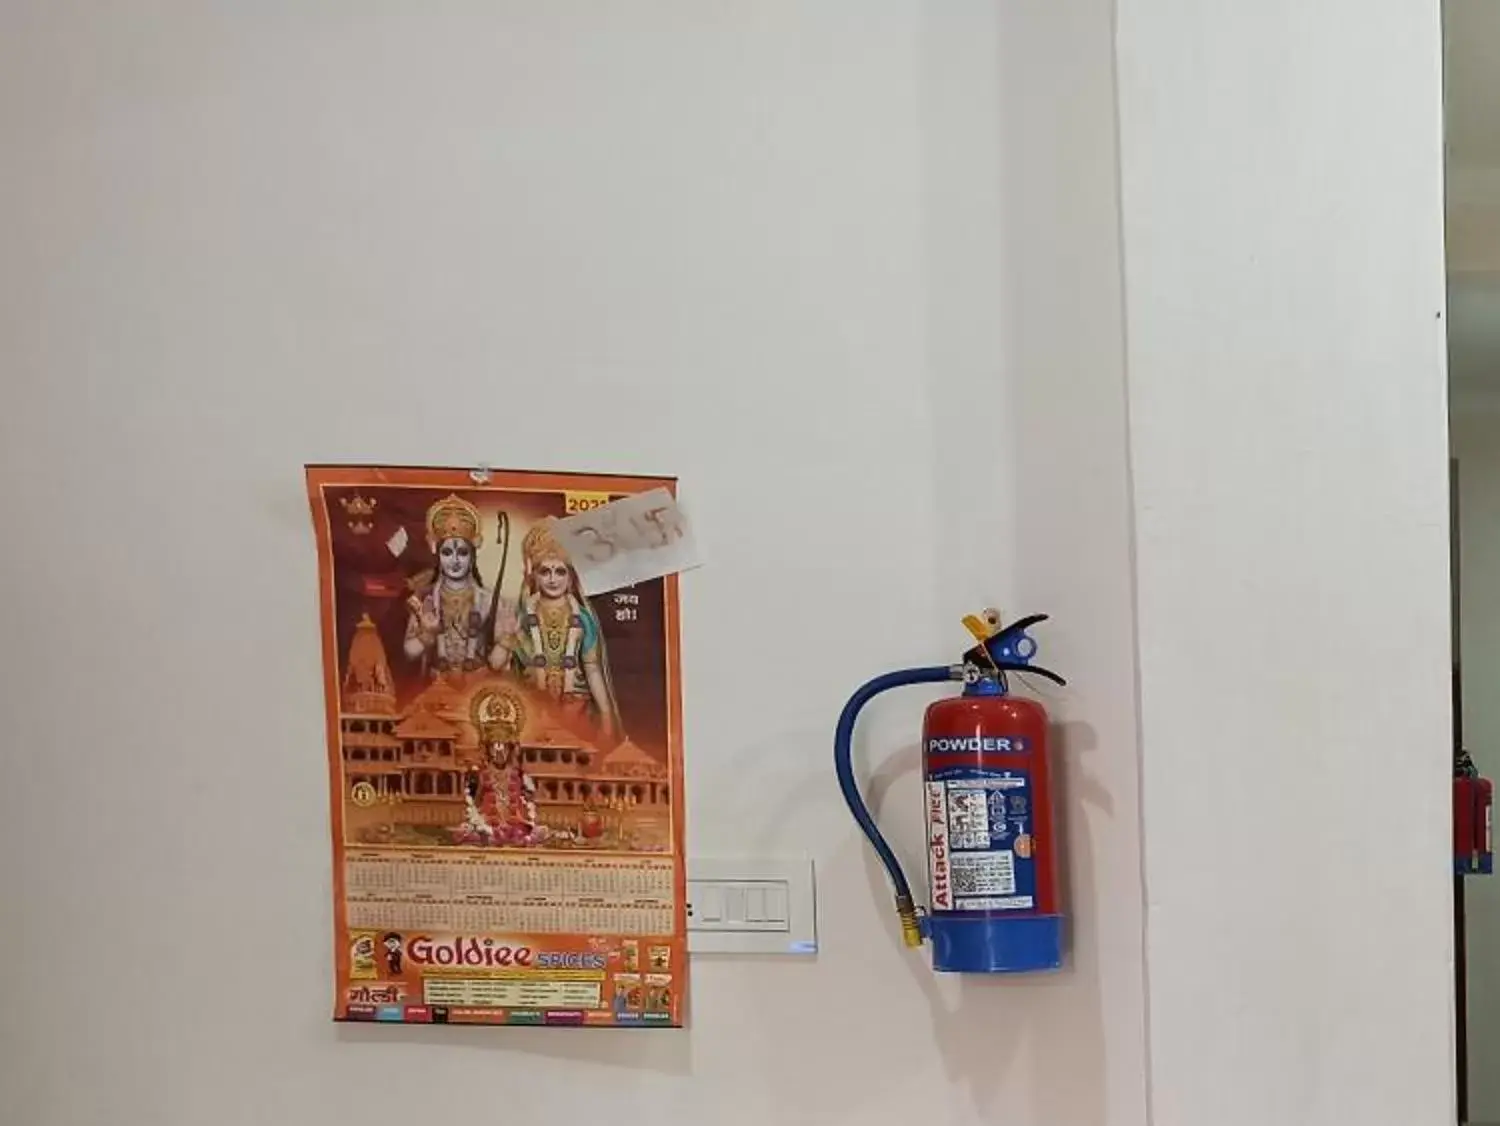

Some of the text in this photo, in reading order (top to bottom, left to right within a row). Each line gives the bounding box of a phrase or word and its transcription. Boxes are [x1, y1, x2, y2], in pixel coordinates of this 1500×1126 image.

[929, 738, 1012, 752] POWDER
[930, 834, 949, 907] Attack
[407, 935, 532, 967] Goldiee
[350, 985, 398, 1003] गोल्डी
